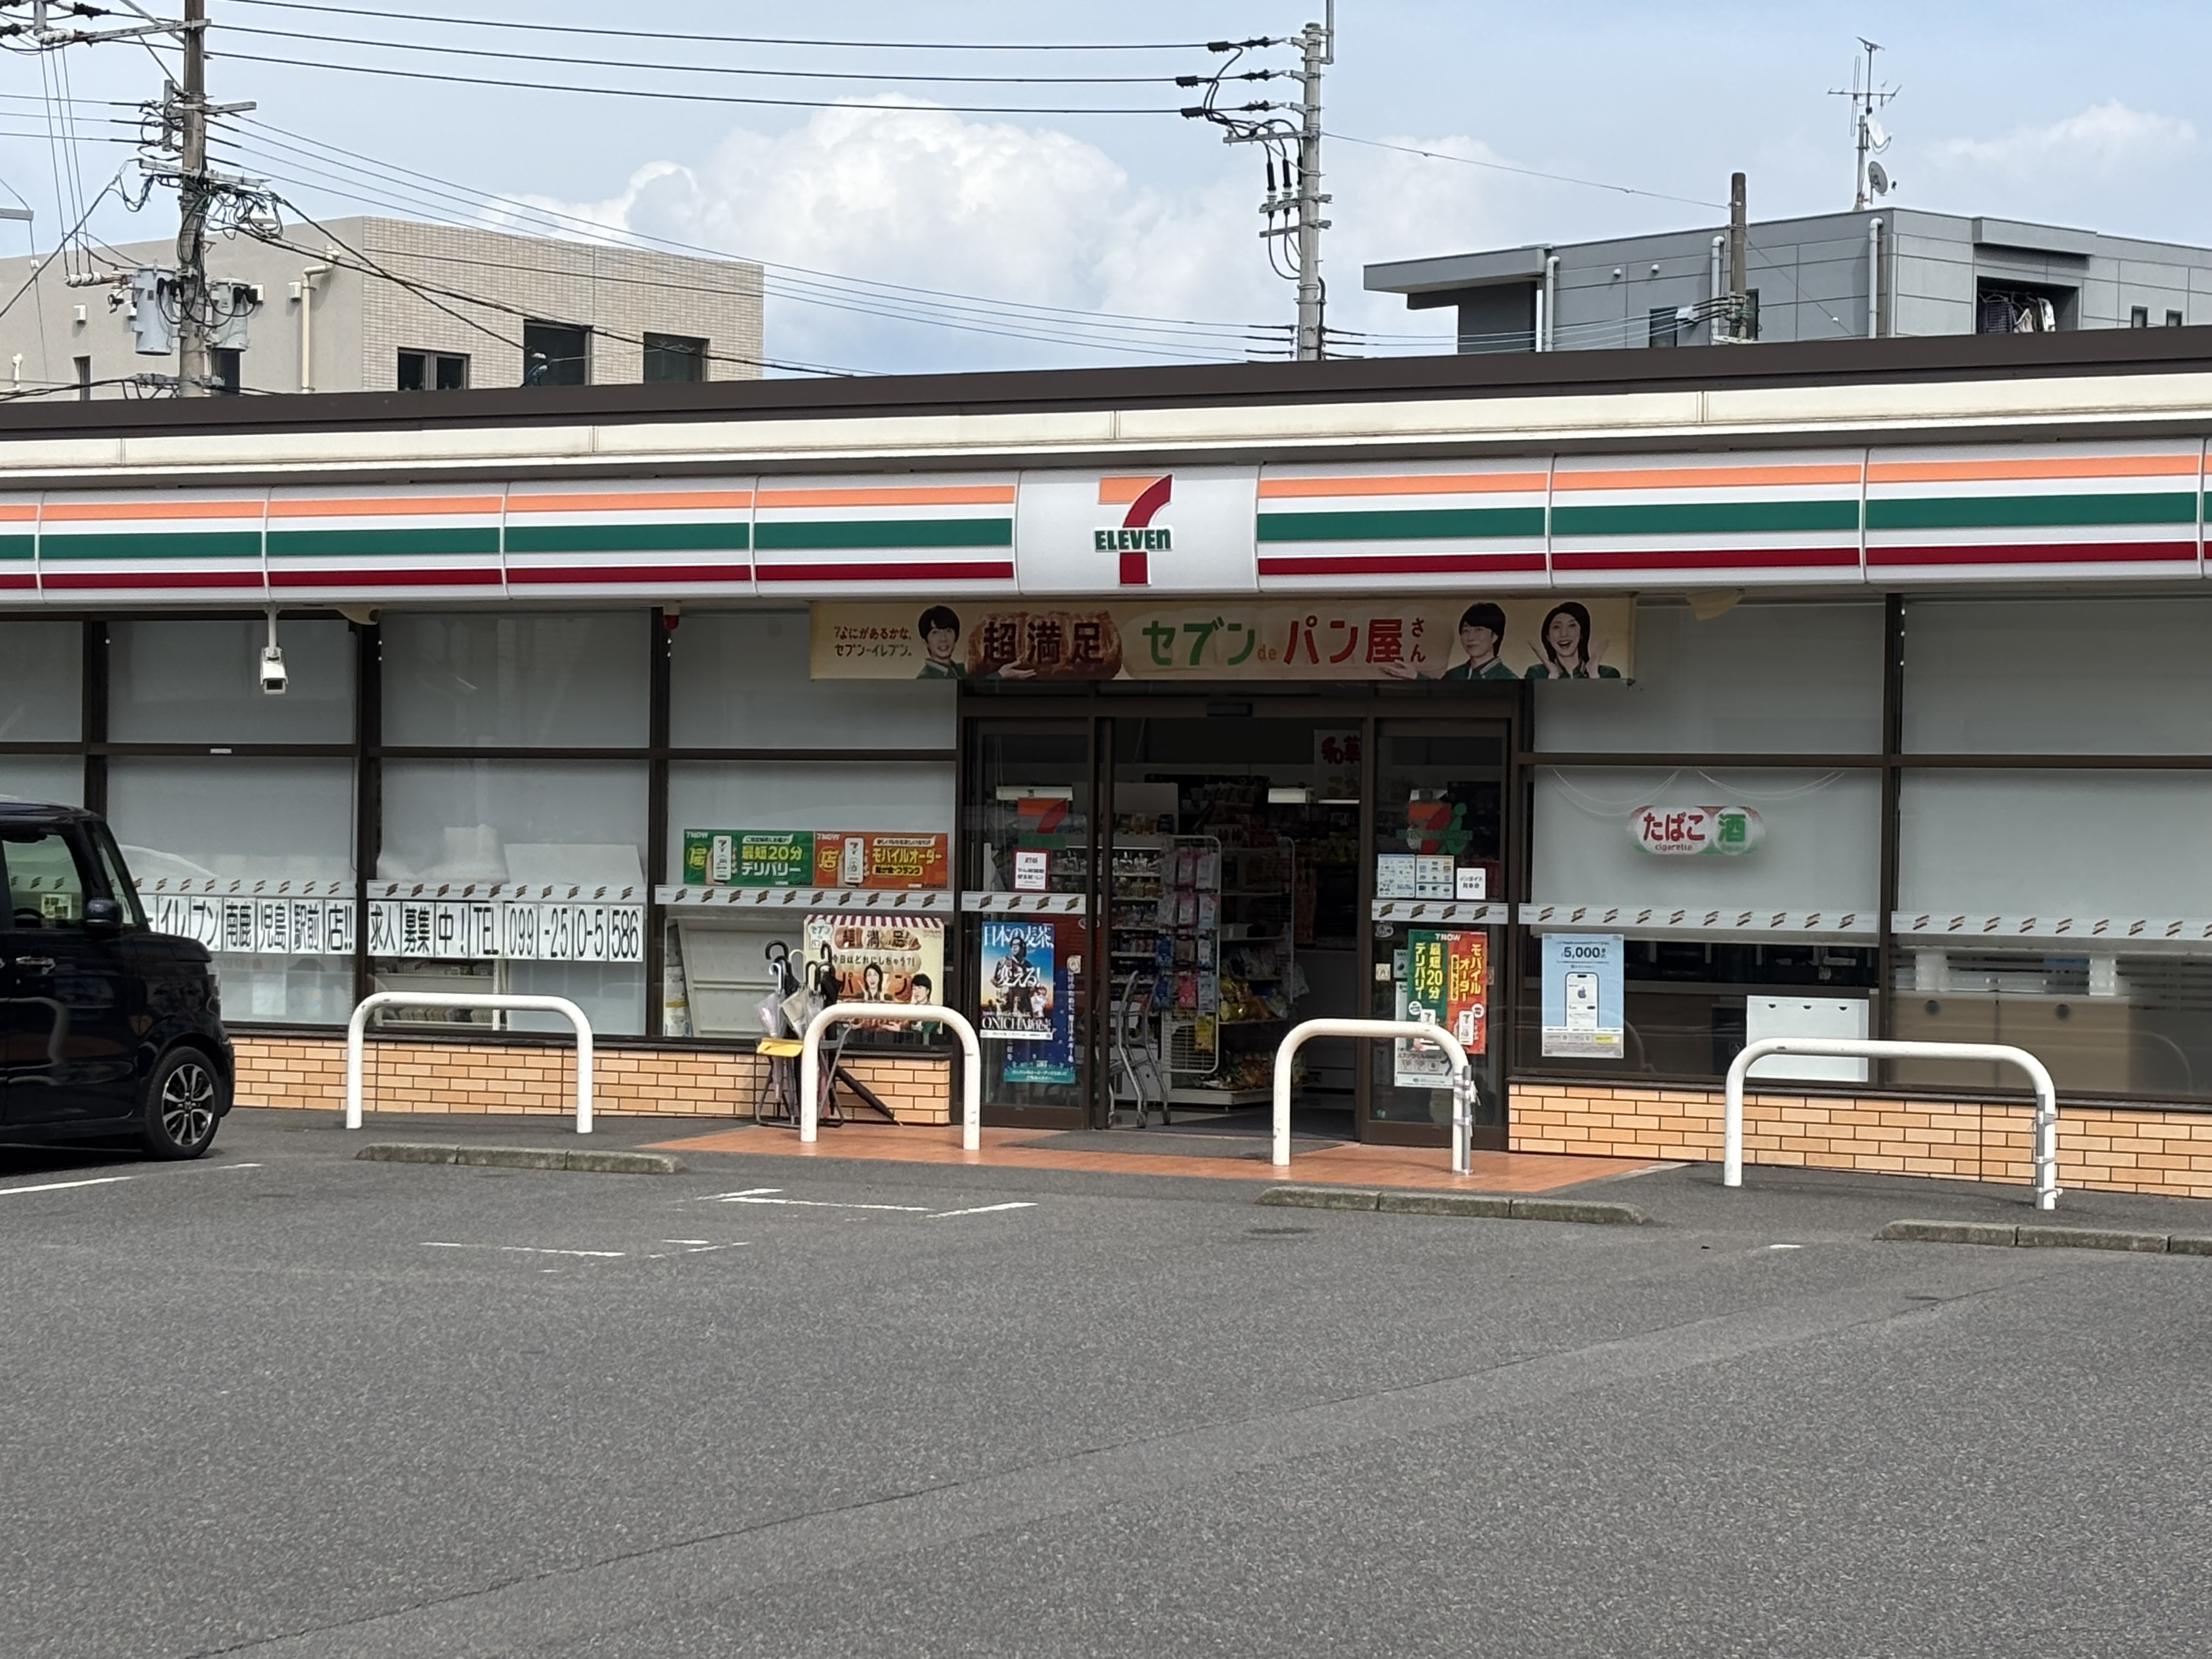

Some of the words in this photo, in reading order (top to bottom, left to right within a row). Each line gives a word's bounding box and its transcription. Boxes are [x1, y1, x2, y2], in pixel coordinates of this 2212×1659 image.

[1098, 473, 1173, 584] 7
[983, 620, 1105, 664] 超満足
[1644, 812, 1705, 842] たばこ
[1718, 813, 1746, 842] 酒
[742, 845, 803, 861] 最短20分
[742, 861, 802, 877] デリバリー
[872, 848, 943, 865] モバイルオーダー
[1414, 942, 1426, 1000] デリバリー
[1459, 960, 1470, 1002] オーダー
[1470, 944, 1482, 994] モバイル
